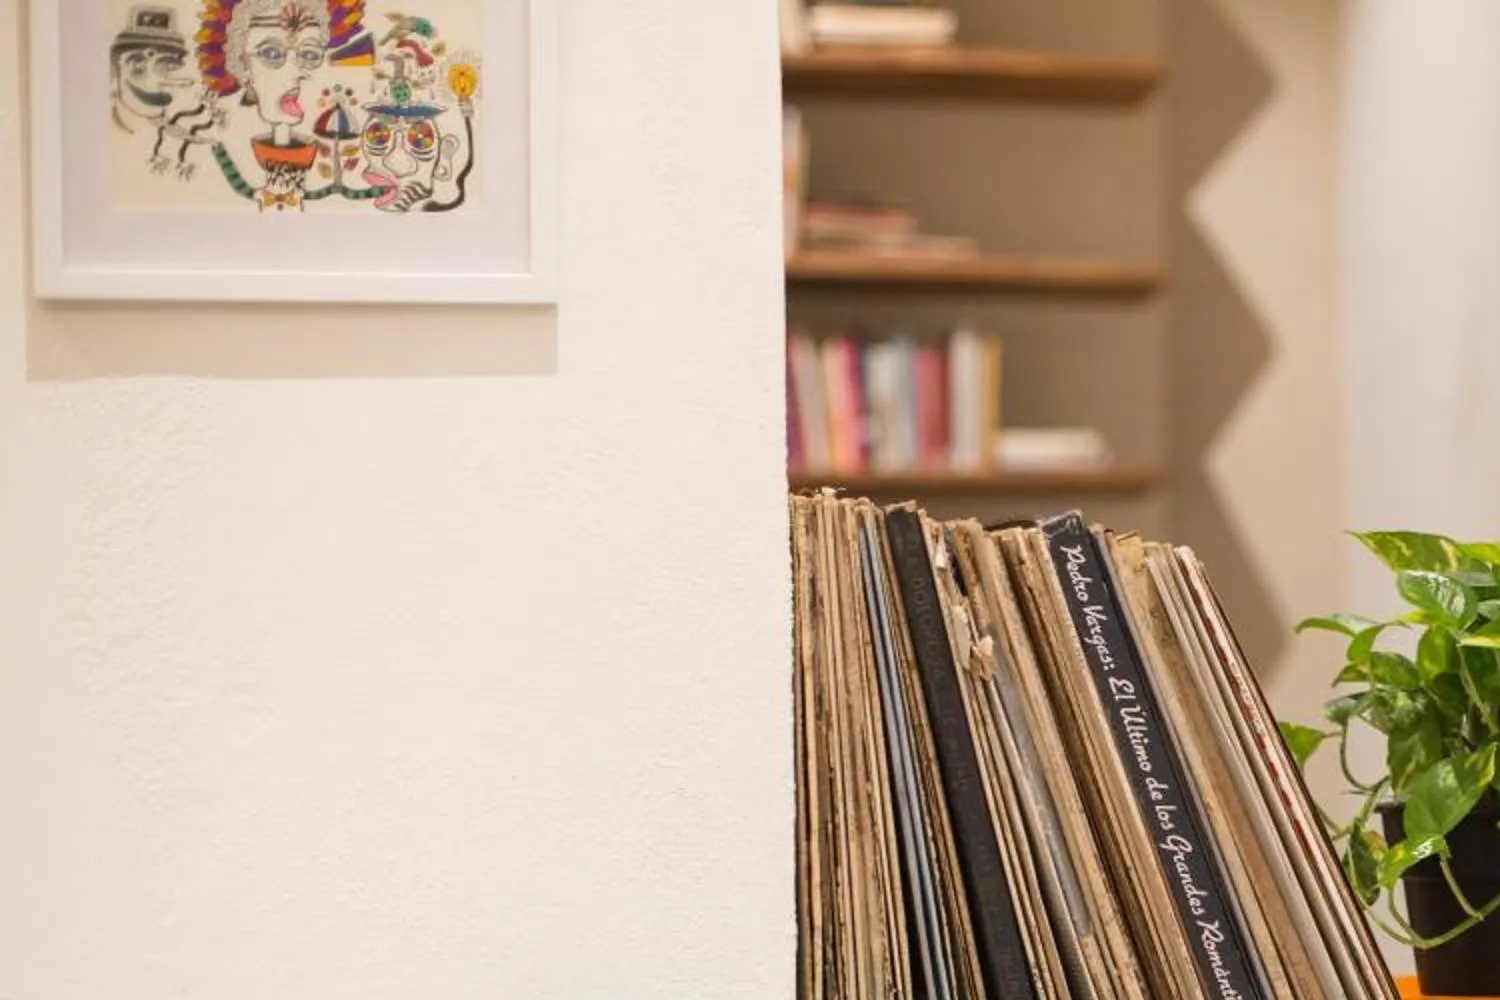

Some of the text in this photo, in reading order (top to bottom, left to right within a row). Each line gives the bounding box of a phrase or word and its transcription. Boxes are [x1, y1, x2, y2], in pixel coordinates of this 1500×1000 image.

[1060, 544, 1093, 602] Pedro
[1082, 605, 1116, 671] Vargas:
[1108, 676, 1137, 701] El
[1145, 777, 1169, 801] de
[1155, 805, 1177, 831] los
[1159, 835, 1208, 916] Grandes
